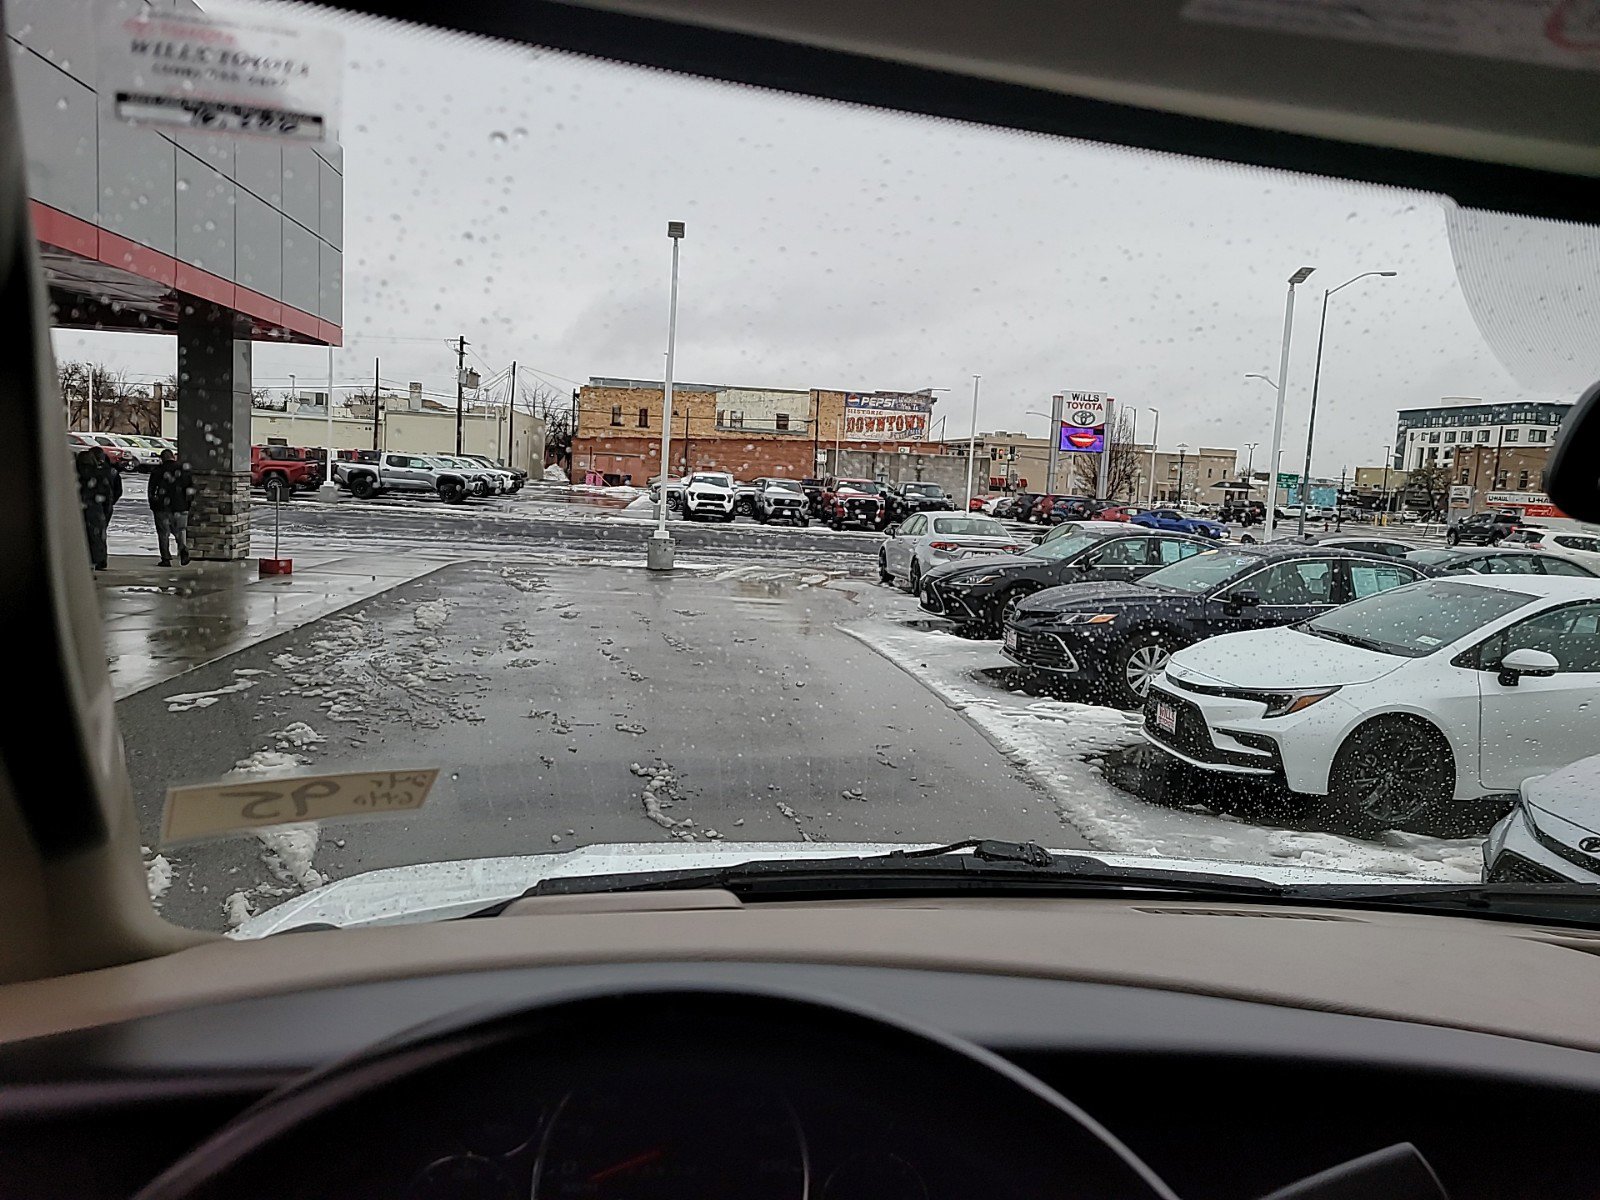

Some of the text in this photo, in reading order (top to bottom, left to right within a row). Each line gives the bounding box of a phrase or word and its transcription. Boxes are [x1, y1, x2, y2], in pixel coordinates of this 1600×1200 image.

[1071, 392, 1100, 402] WILLS
[861, 397, 895, 408] PEPSI
[1066, 401, 1103, 411] TOYOTA
[847, 408, 884, 416] HISTORIC
[846, 414, 926, 433] DOWNTOWN
